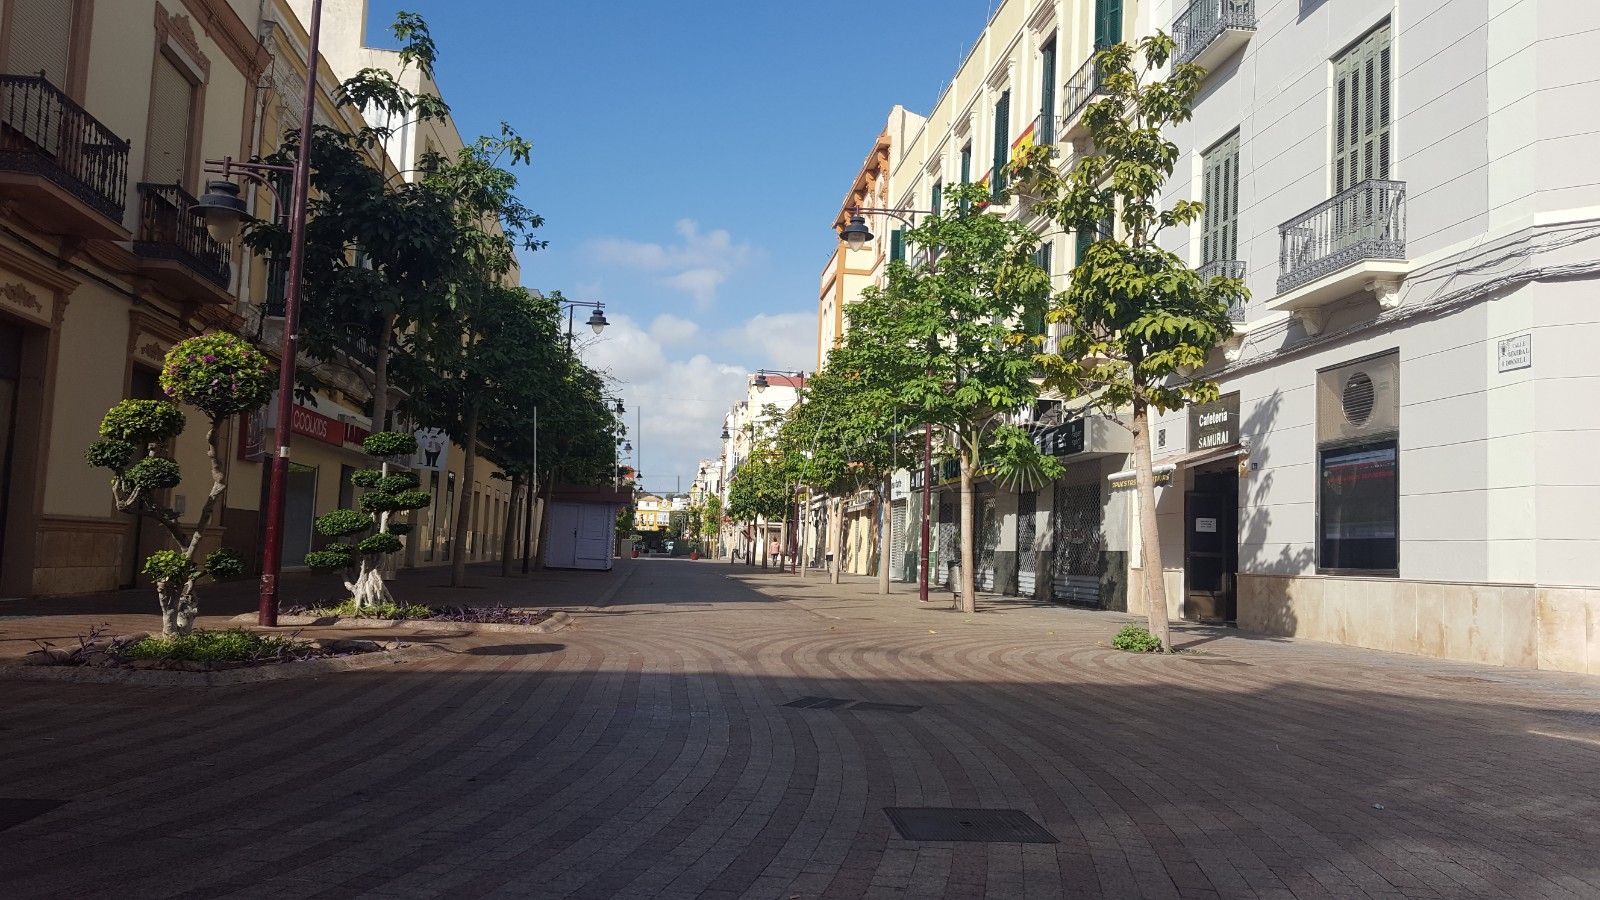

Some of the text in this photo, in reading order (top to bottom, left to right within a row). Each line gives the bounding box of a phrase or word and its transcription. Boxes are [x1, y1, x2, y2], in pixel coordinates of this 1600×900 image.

[293, 410, 328, 438] COOLKIDS
[1198, 408, 1228, 428] Cafetería
[1198, 430, 1229, 449] SAMURAI
